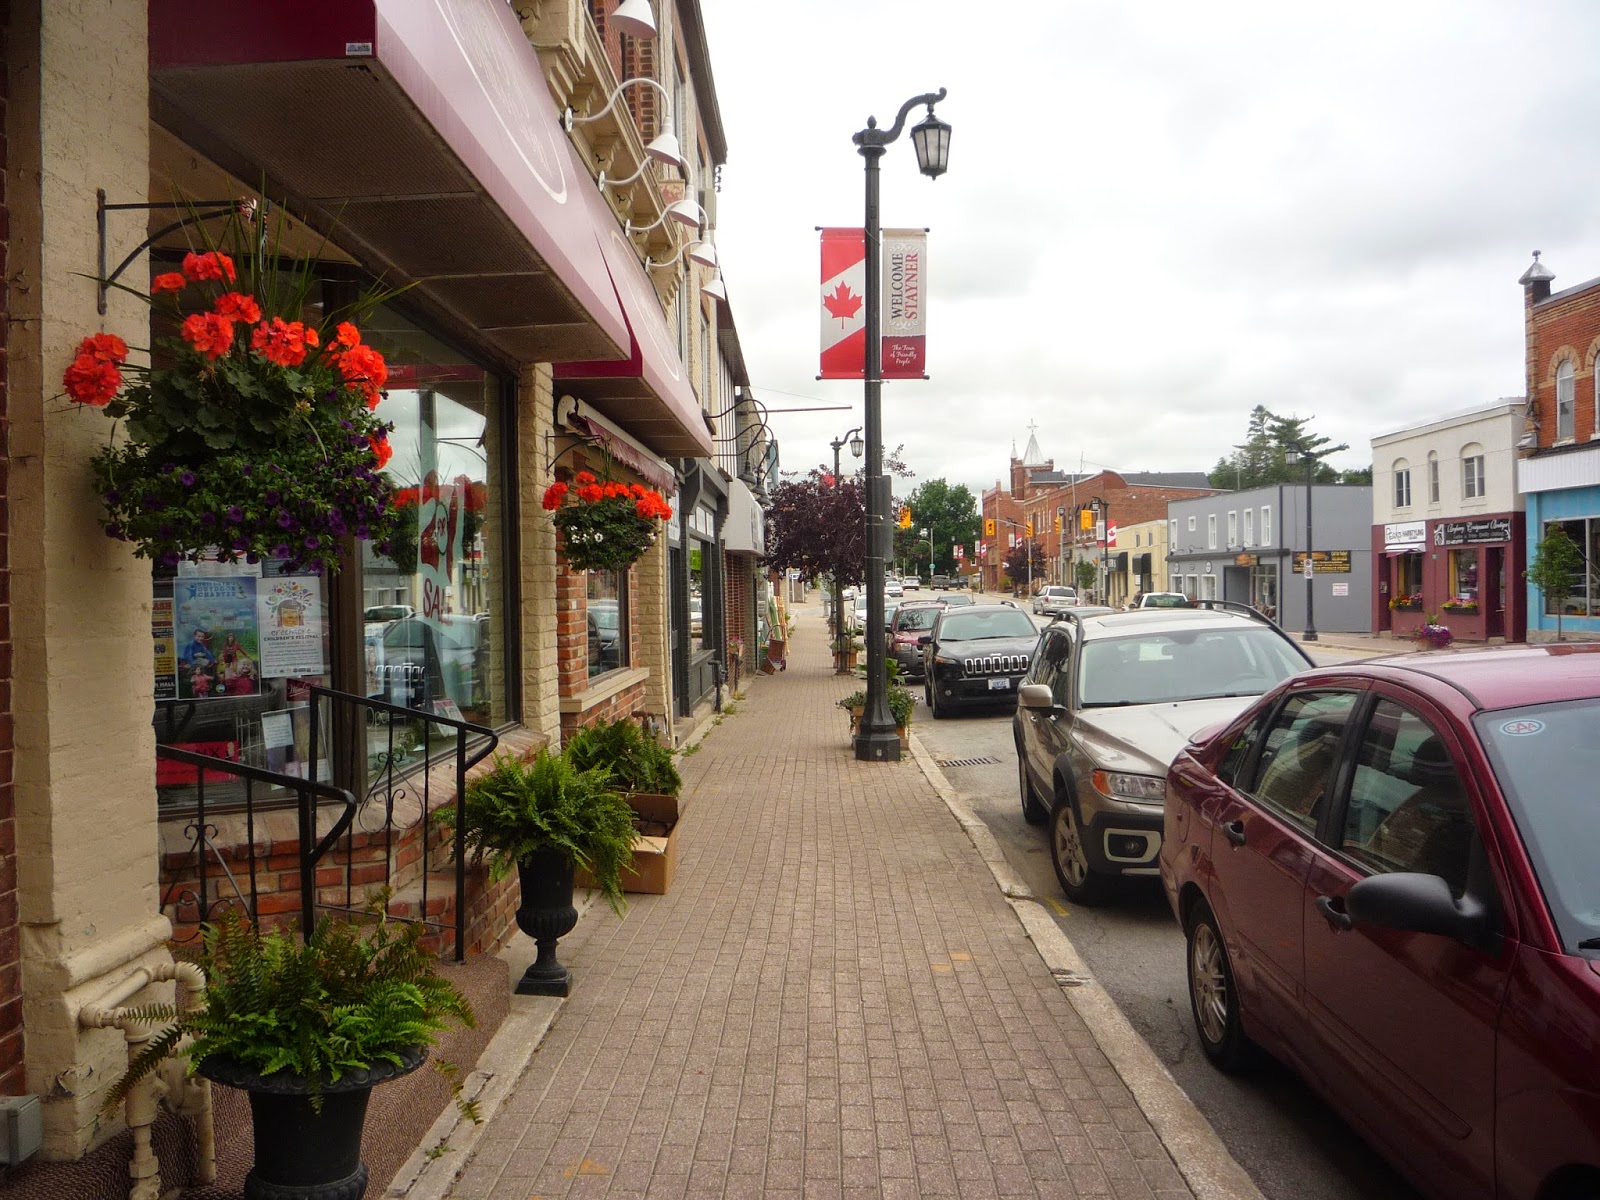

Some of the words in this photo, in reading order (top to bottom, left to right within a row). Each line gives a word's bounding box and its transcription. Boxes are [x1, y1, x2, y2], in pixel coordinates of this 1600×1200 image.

[891, 252, 904, 320] WELCOME
[905, 252, 918, 320] STAYNER
[895, 358, 911, 367] People
[896, 351, 917, 359] Friendly
[423, 577, 454, 627] SALE
